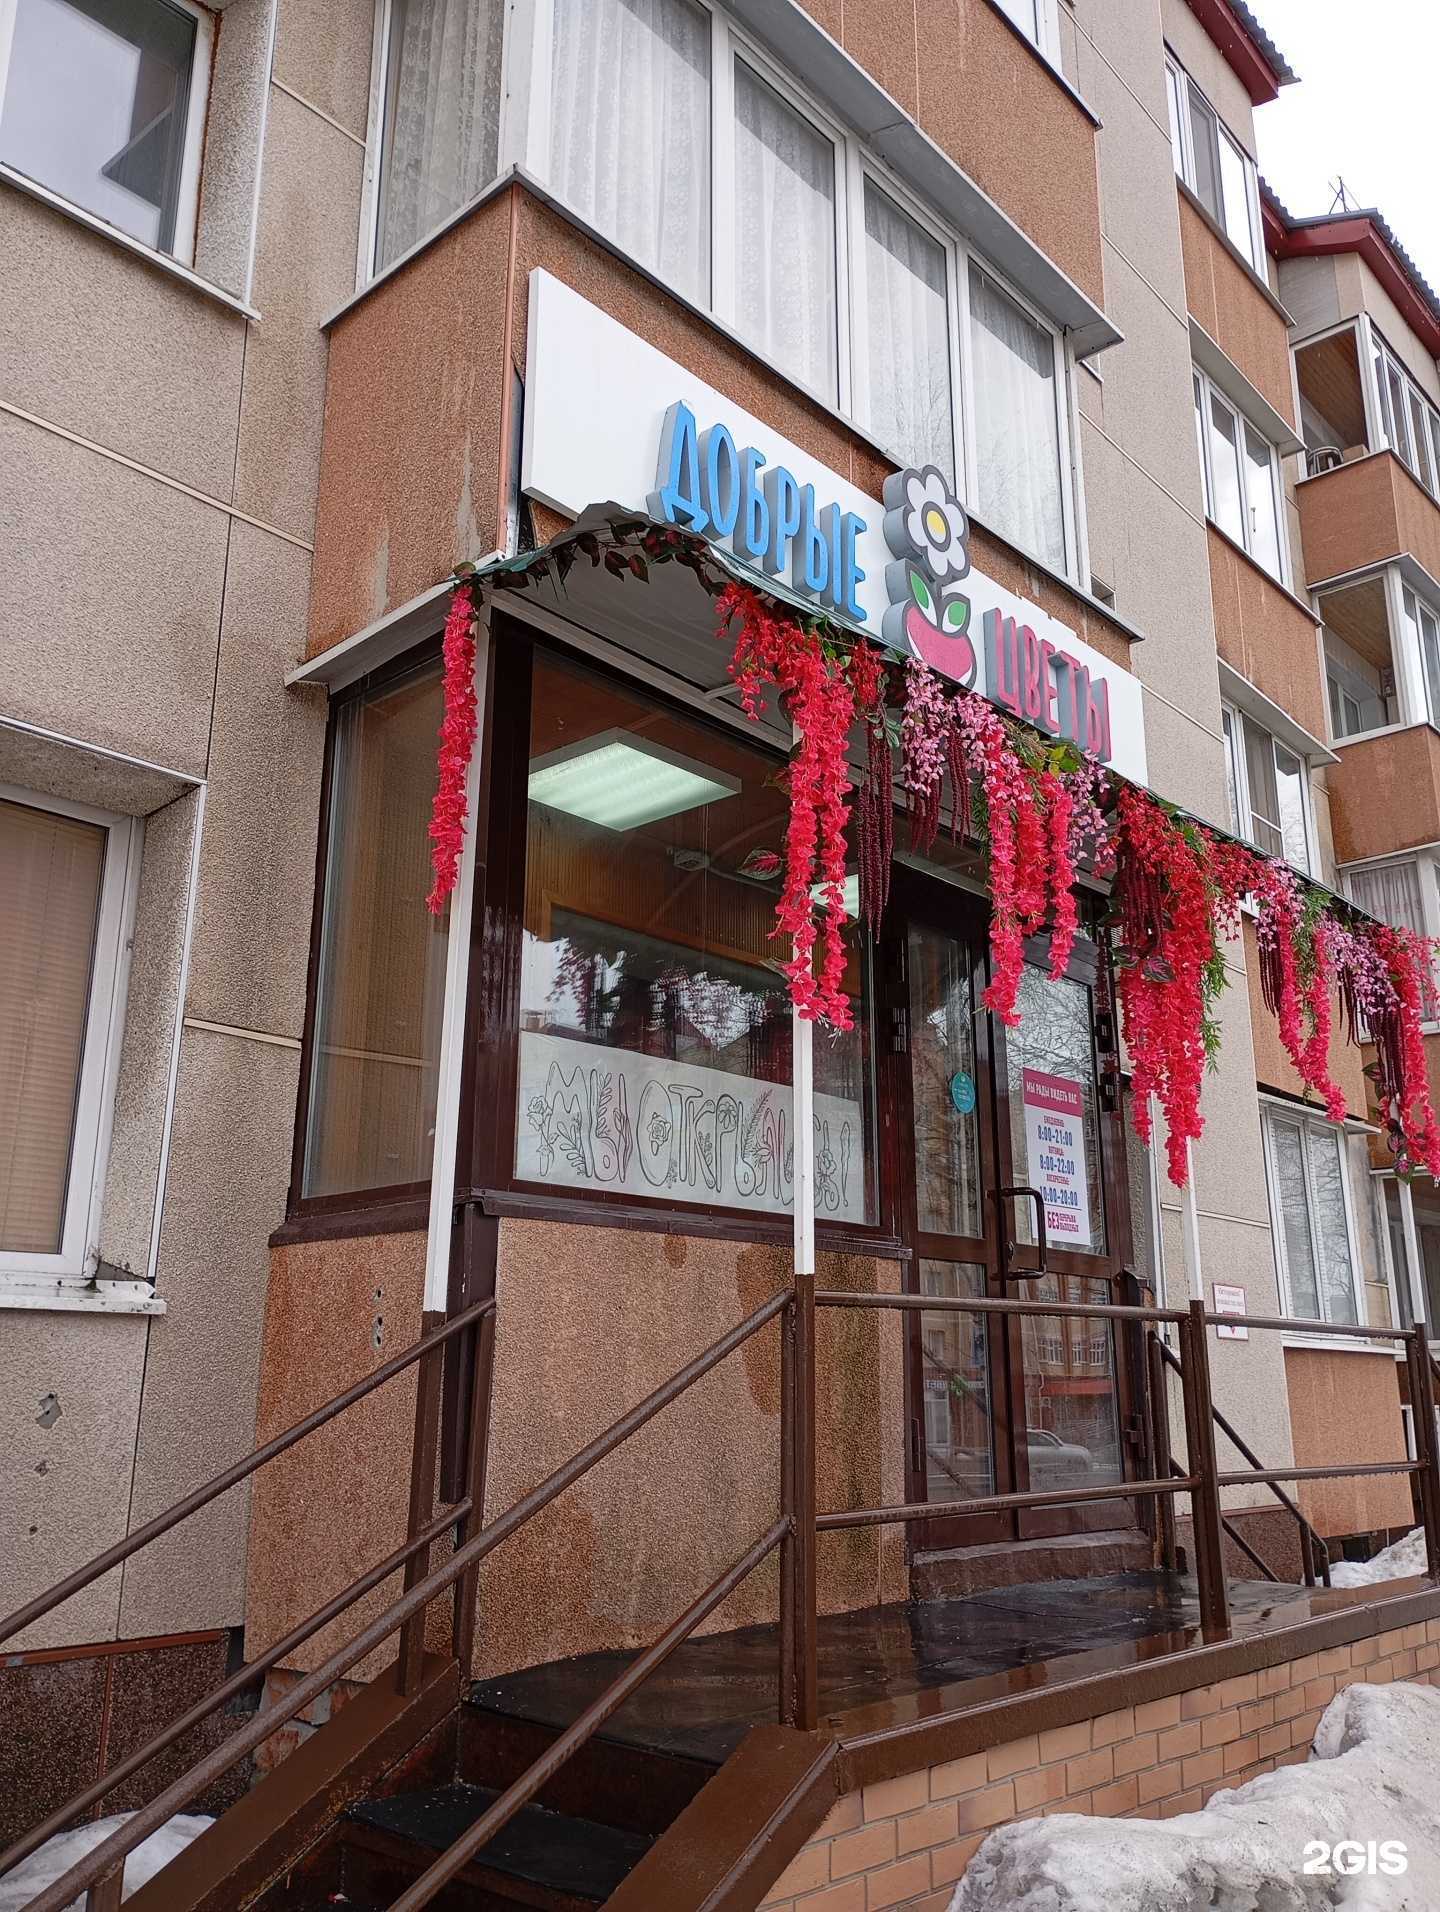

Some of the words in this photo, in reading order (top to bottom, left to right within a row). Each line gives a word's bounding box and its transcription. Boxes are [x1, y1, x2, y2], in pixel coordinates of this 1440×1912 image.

[649, 399, 867, 623] ДОБРЫЕ
[983, 607, 1112, 763] ЦВЕТЫ
[1026, 1081, 1035, 1093] МЫ
[1037, 1124, 1073, 1147] 8:00-21:00
[1039, 1154, 1075, 1176] 8:00-22:00
[1047, 1211, 1060, 1230] БЕЗ
